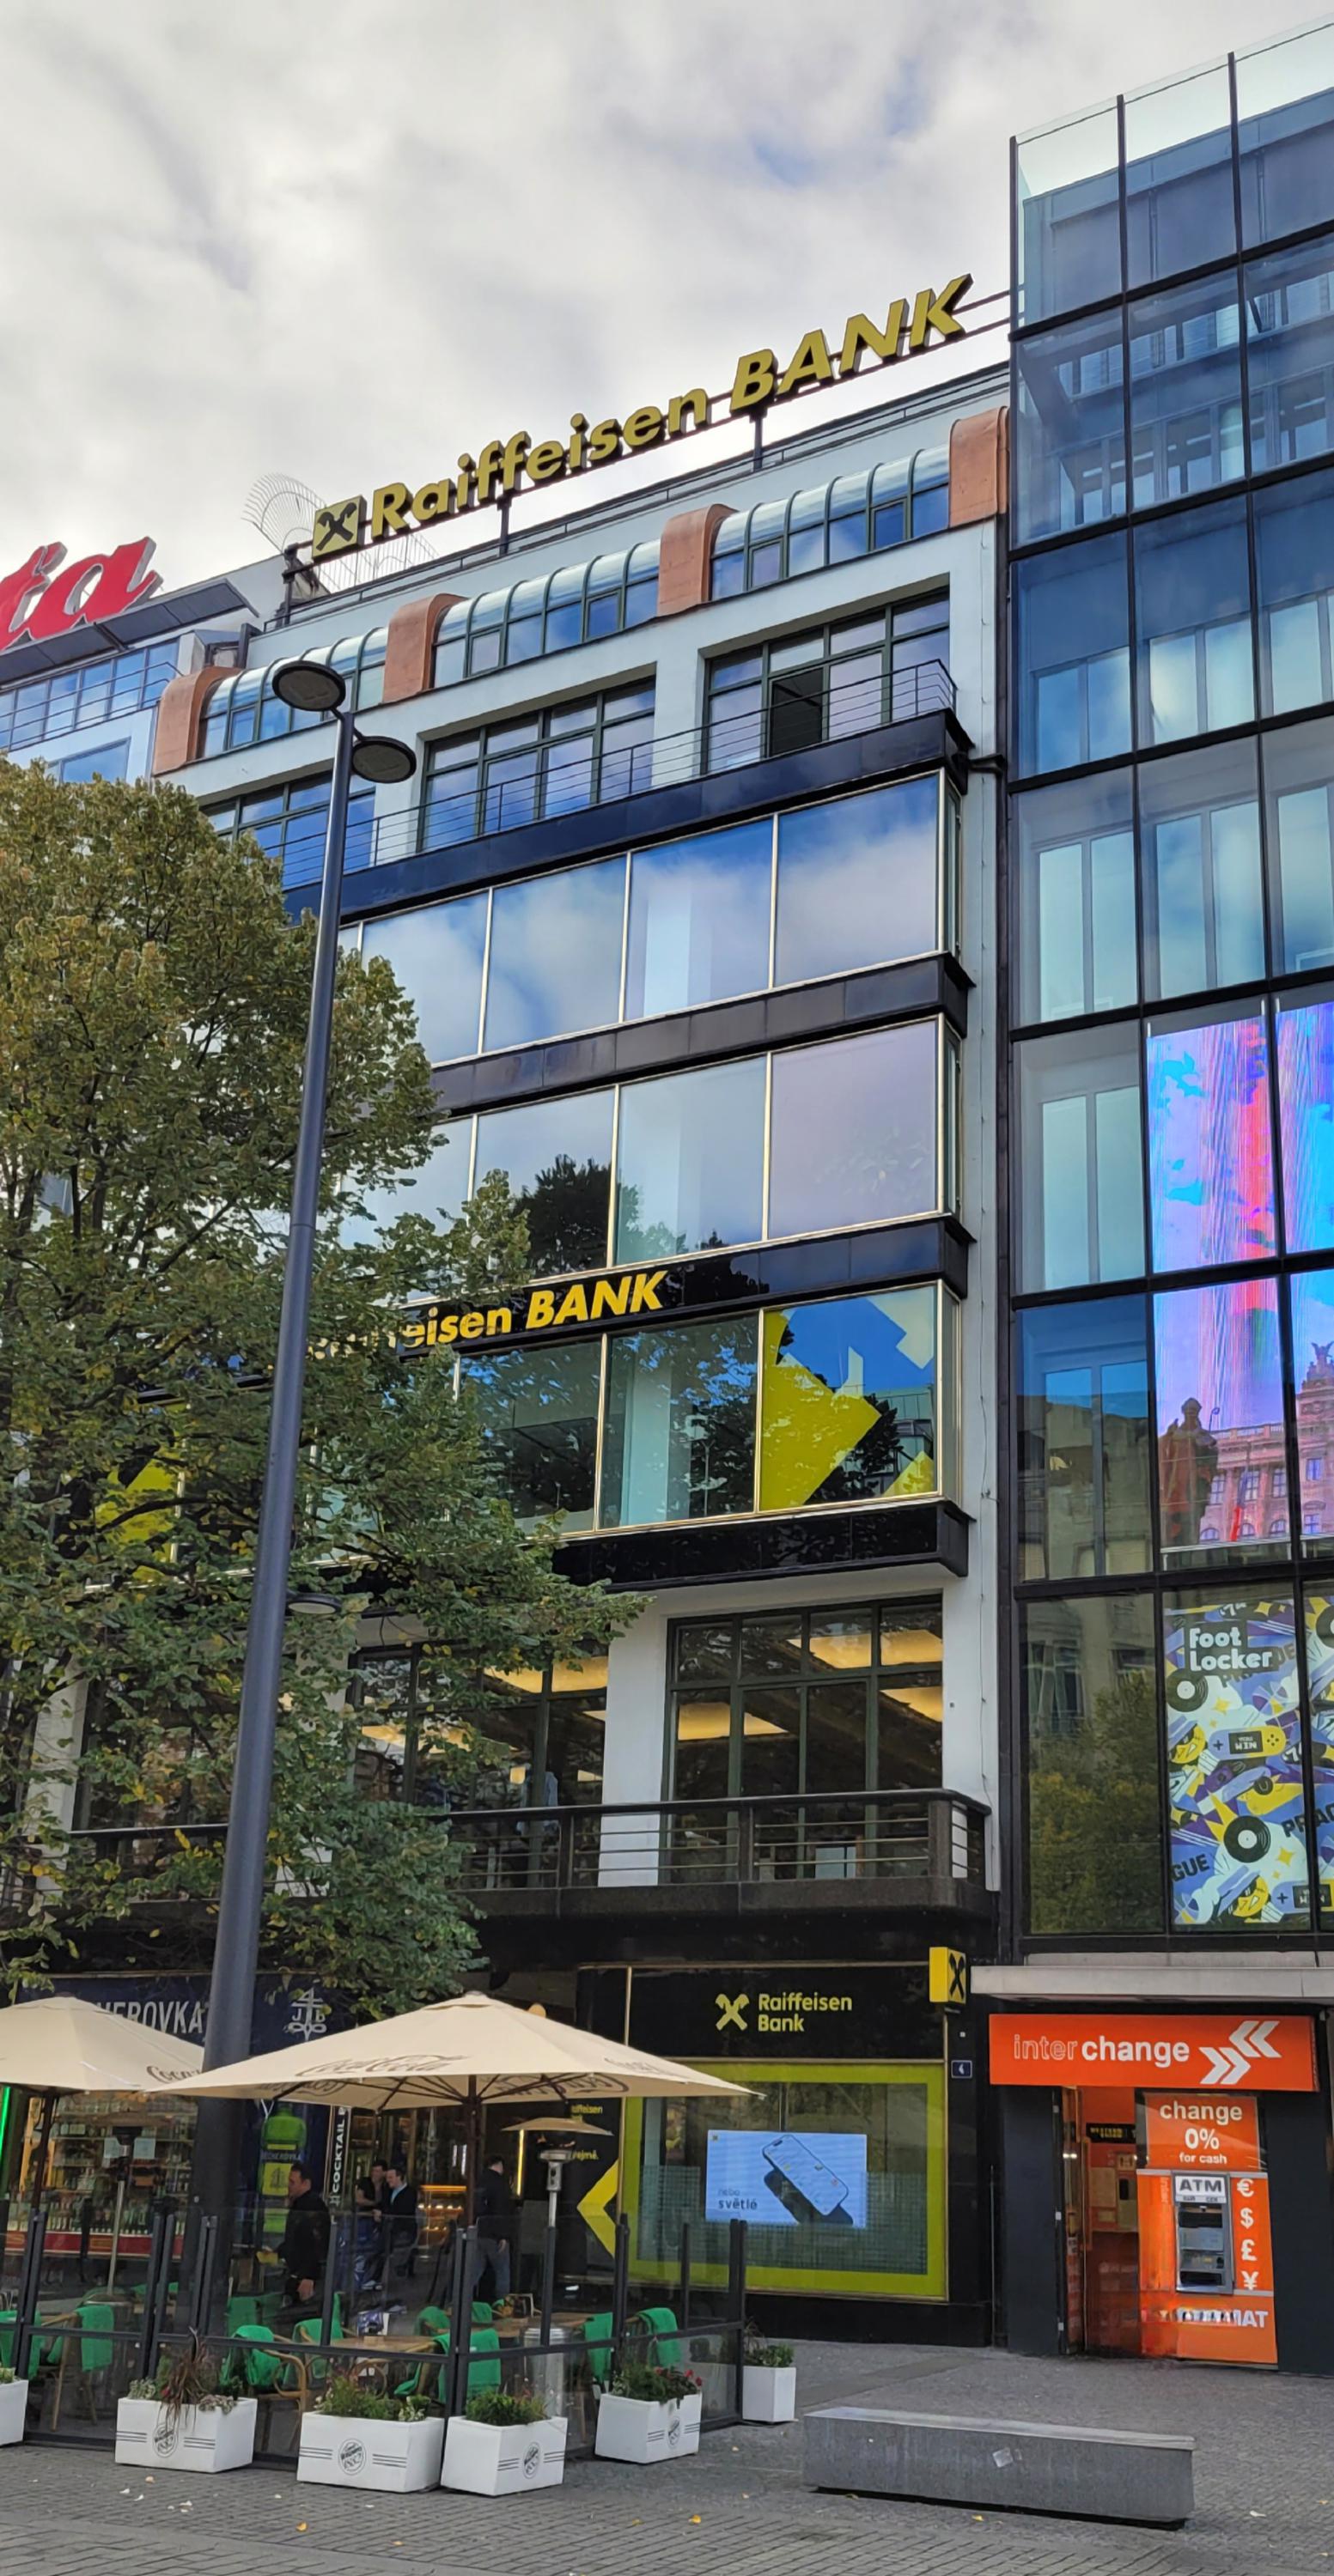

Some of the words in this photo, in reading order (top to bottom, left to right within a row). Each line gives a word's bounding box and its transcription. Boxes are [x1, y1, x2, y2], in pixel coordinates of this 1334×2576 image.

[371, 386, 711, 539] Raiffeisen
[730, 274, 974, 412] BANK
[526, 1271, 668, 1329] BANK
[1189, 1627, 1242, 1649] Foot
[1189, 1649, 1273, 1672] Locker
[758, 1991, 853, 2012] Raiffeisen
[758, 2014, 805, 2032] Bank
[1160, 2100, 1243, 2125] change
[1185, 2128, 1220, 2149] 0%
[332, 2118, 345, 2194] COCKTAIL
[1179, 2152, 1197, 2163] for
[1199, 2154, 1227, 2165] cash
[1179, 2178, 1222, 2192] ATM
[1236, 2178, 1255, 2197] €
[1240, 2207, 1254, 2229] $
[1240, 2239, 1258, 2262] £
[1240, 2270, 1259, 2291] ¥
